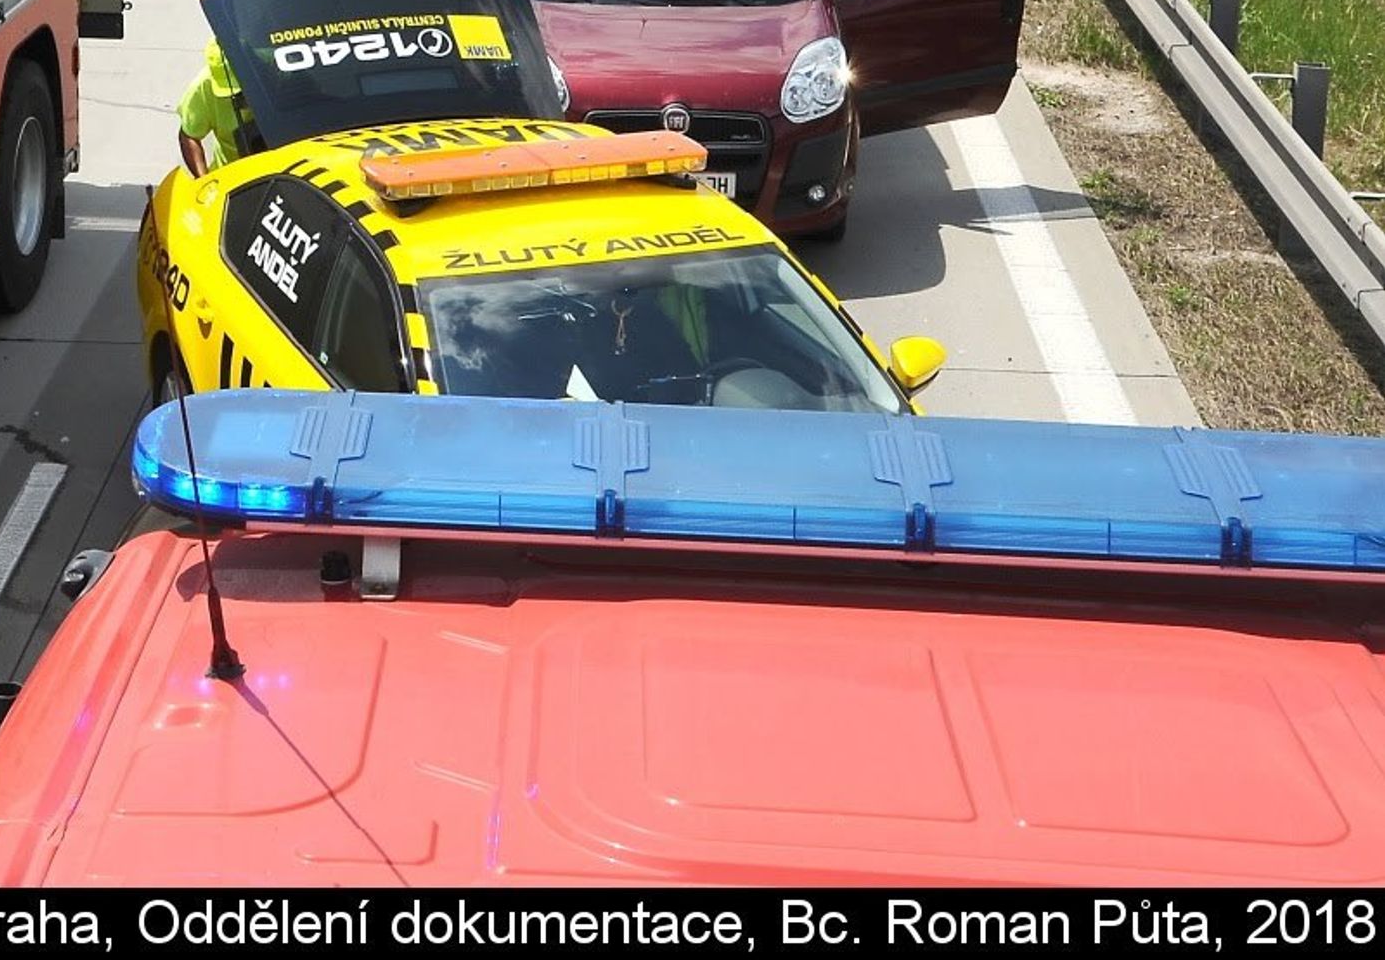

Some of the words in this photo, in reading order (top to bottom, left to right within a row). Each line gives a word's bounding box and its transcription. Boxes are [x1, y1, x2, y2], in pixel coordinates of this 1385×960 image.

[270, 24, 324, 44] POMOCI
[326, 17, 380, 39] SILNIČNÍ
[380, 14, 444, 29] CENTRÁLA
[273, 32, 419, 72] 1240
[261, 194, 322, 265] ŽLUTÝ
[442, 237, 588, 270] ŽLUTÝ
[605, 224, 746, 255] ANDĚL
[247, 234, 300, 304] ANDĚL
